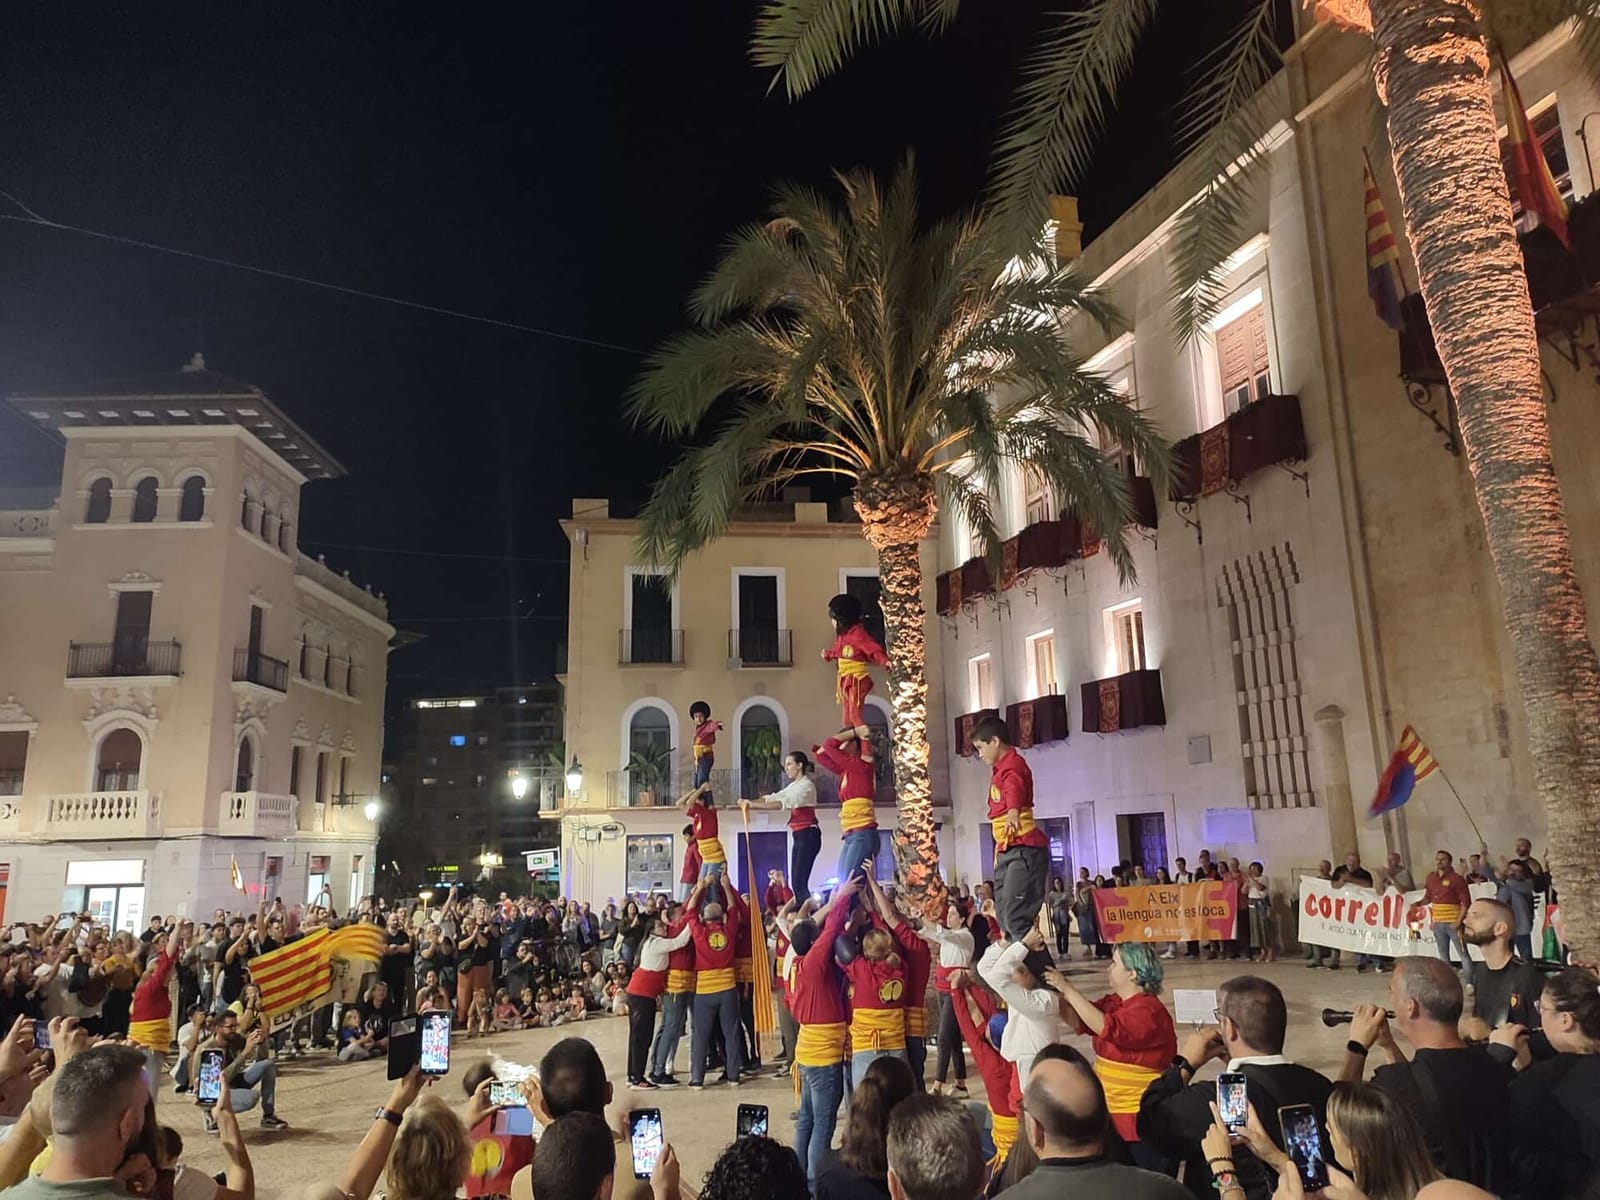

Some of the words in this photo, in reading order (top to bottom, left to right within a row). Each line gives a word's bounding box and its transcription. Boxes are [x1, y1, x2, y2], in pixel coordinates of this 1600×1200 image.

[1147, 893, 1156, 904] A
[1160, 892, 1179, 904] Elx
[1106, 910, 1117, 920] la
[1120, 907, 1162, 922] llengua
[1184, 908, 1196, 918] es
[1304, 893, 1434, 930] correlle
